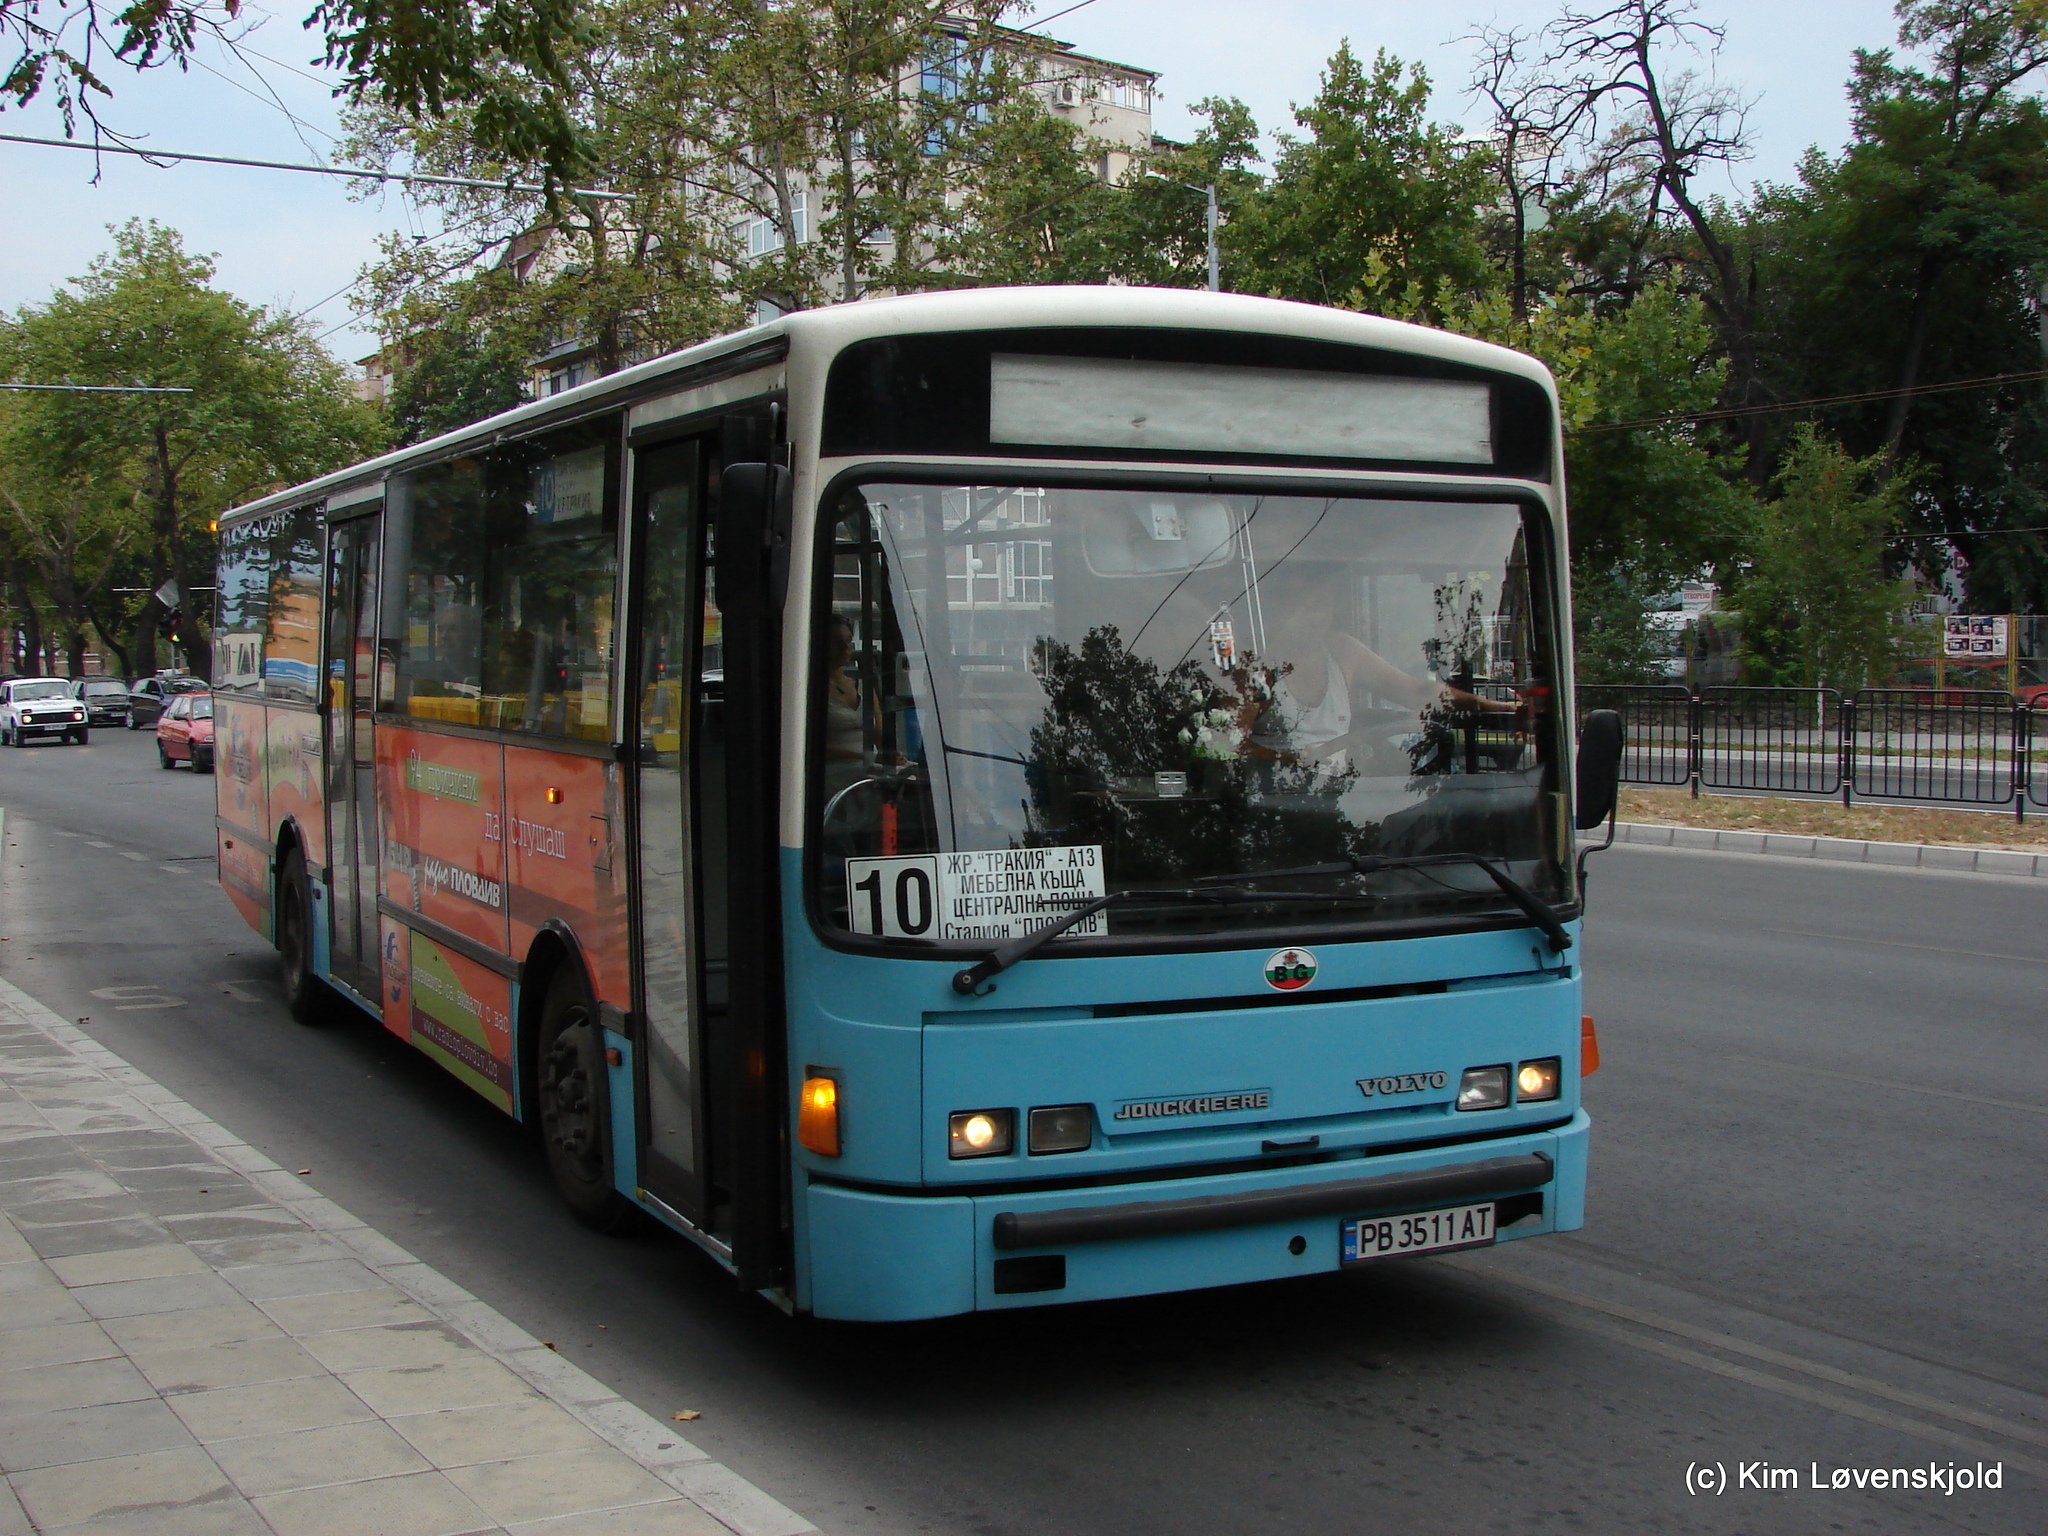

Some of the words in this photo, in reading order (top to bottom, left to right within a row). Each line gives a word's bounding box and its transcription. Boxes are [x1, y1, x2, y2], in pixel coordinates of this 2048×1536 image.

[410, 749, 422, 787] 94
[427, 767, 477, 802] причини
[485, 812, 502, 842] да
[510, 817, 566, 859] слушаш
[947, 854, 977, 874] ЖР.
[1068, 847, 1096, 868] А13
[961, 871, 1036, 895] МЕБЕЛНА
[1040, 868, 1086, 891] КЪЩА
[855, 868, 932, 936] 10
[953, 893, 1046, 921] ЦЕНТРАЛНА
[945, 922, 1010, 940] Стадион
[1274, 964, 1308, 983] BG
[493, 1010, 509, 1034] вас
[1357, 1070, 1449, 1097] VOLVO
[1114, 1091, 1271, 1120] JONCKHEERE
[1361, 1221, 1394, 1254] PB
[1398, 1212, 1454, 1248] 3511
[1461, 1206, 1491, 1239] AT
